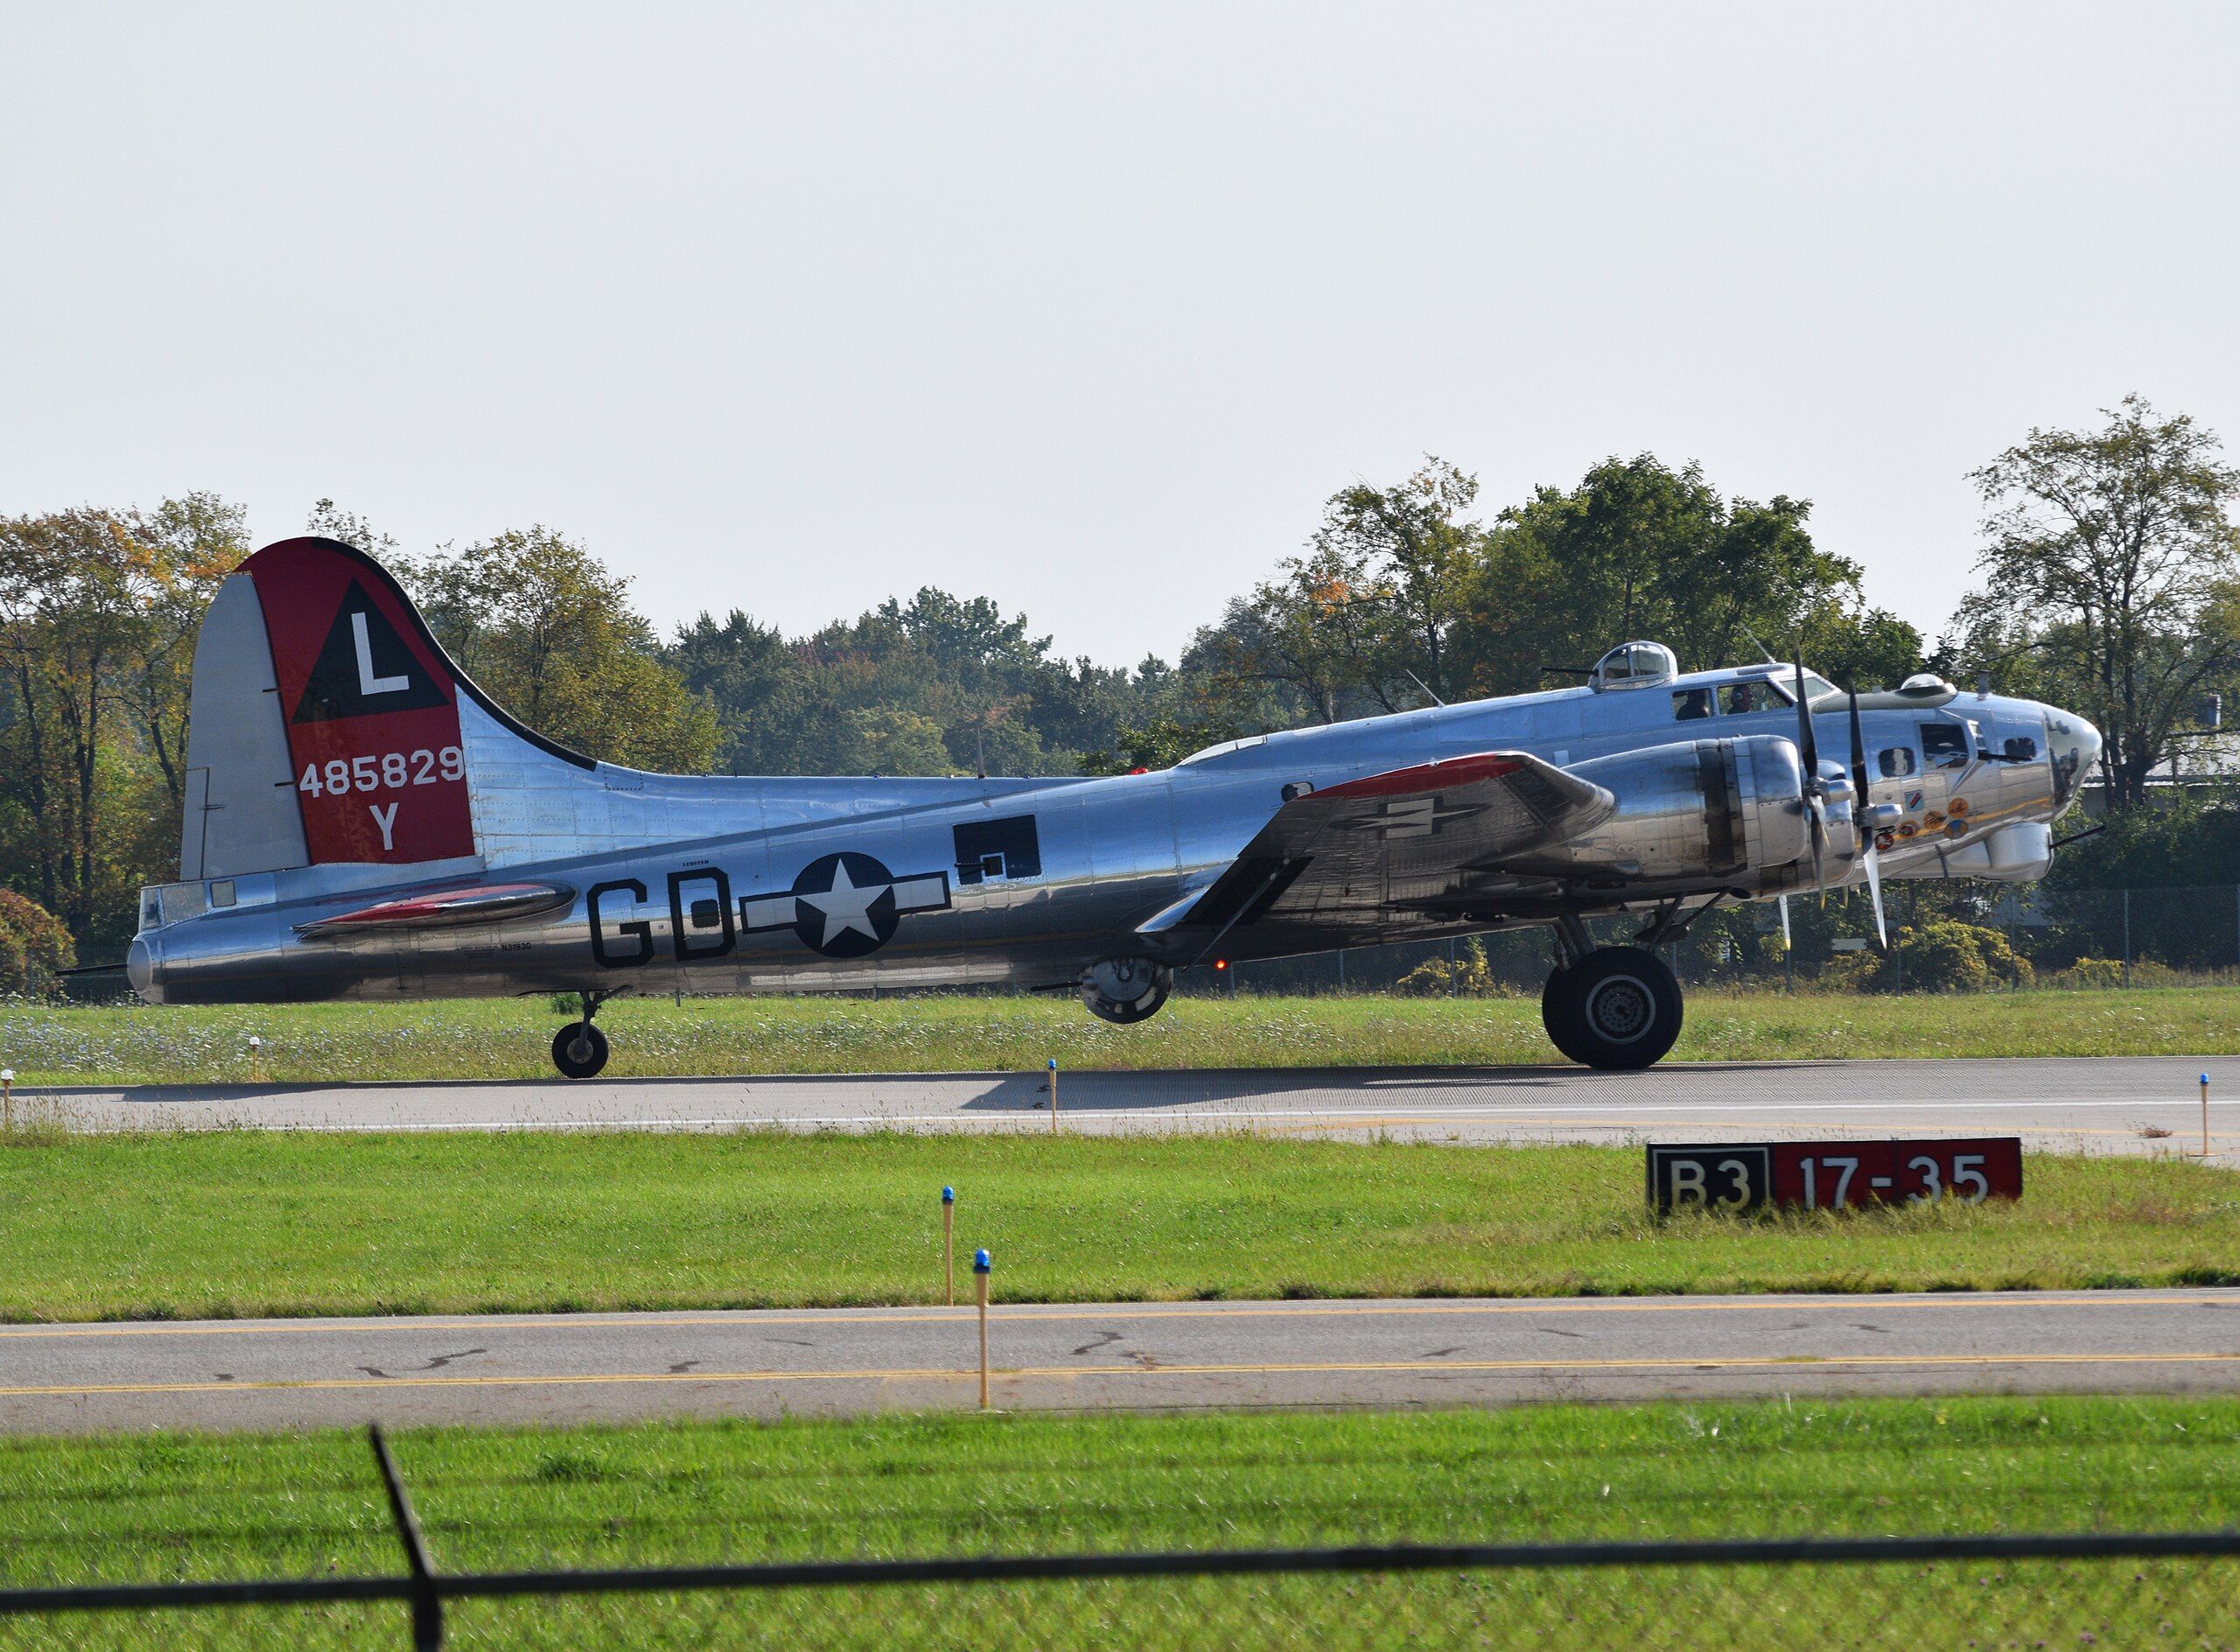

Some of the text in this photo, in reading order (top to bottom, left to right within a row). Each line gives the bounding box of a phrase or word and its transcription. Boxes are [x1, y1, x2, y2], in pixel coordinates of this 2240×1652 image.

[351, 612, 410, 696] L
[299, 746, 466, 799] 485829
[368, 802, 399, 851] Y
[1670, 1158, 1751, 1212] B3
[1799, 1155, 1989, 1211] 17-35
